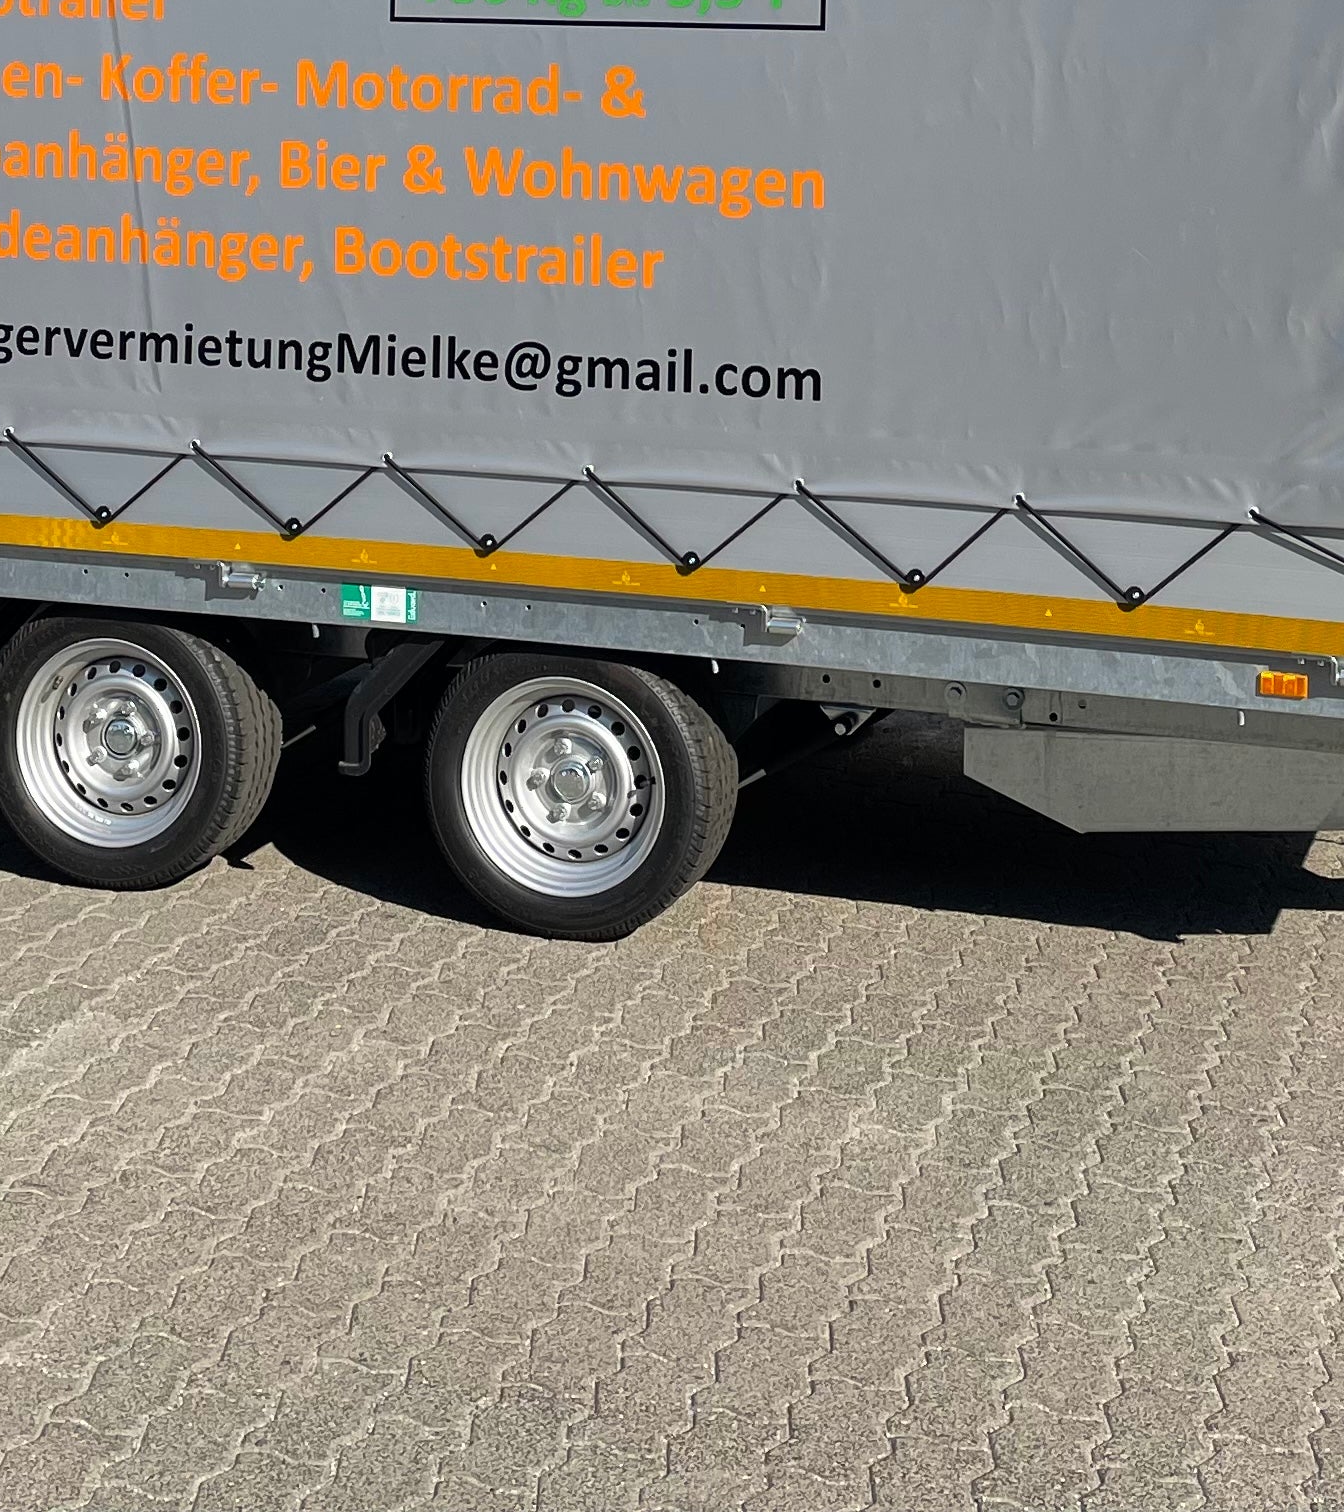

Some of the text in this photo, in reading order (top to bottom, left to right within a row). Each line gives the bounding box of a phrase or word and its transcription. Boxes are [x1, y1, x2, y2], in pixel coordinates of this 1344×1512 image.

[100, 52, 279, 105] Koffer-
[297, 59, 582, 116] Motorrad-
[600, 65, 646, 118] &
[279, 139, 388, 192] Bier
[403, 143, 446, 195] &
[464, 145, 825, 219] Wohnwagen
[334, 225, 665, 289] Bootstrailer
